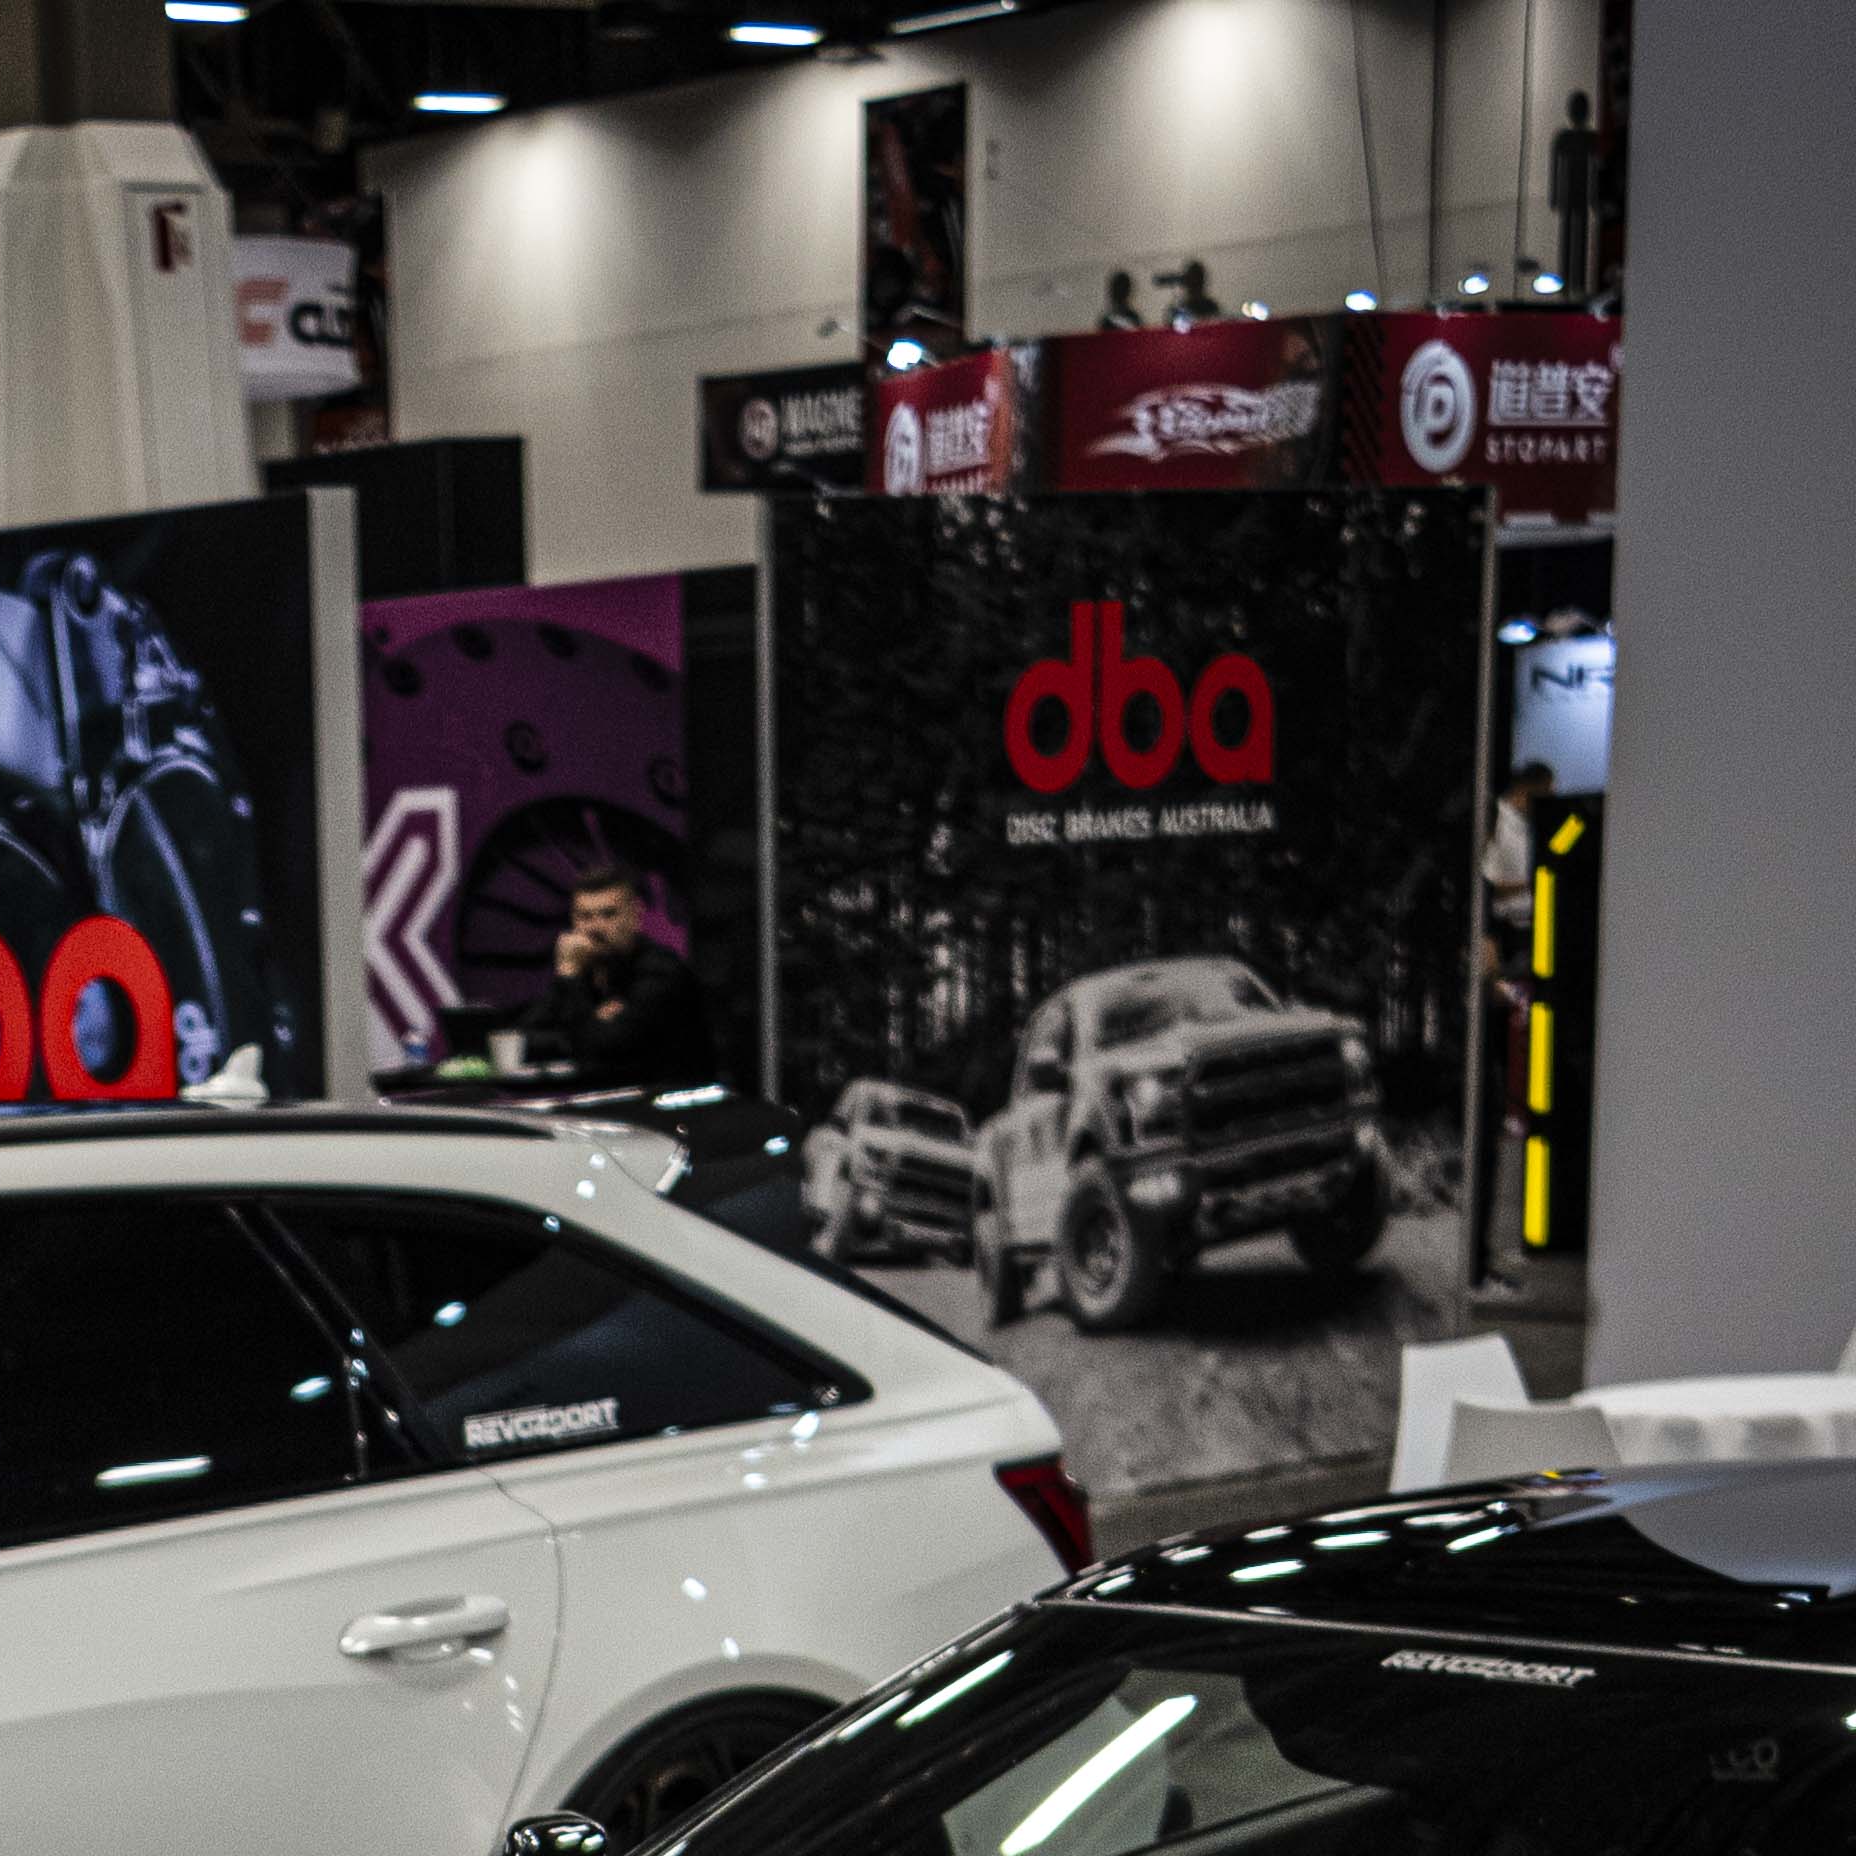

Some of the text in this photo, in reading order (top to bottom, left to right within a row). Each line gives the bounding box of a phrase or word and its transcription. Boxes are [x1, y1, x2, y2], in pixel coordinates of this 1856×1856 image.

[1003, 599, 1275, 794] dba
[1006, 801, 1275, 844] DISC BRAKES AUSTRALIA
